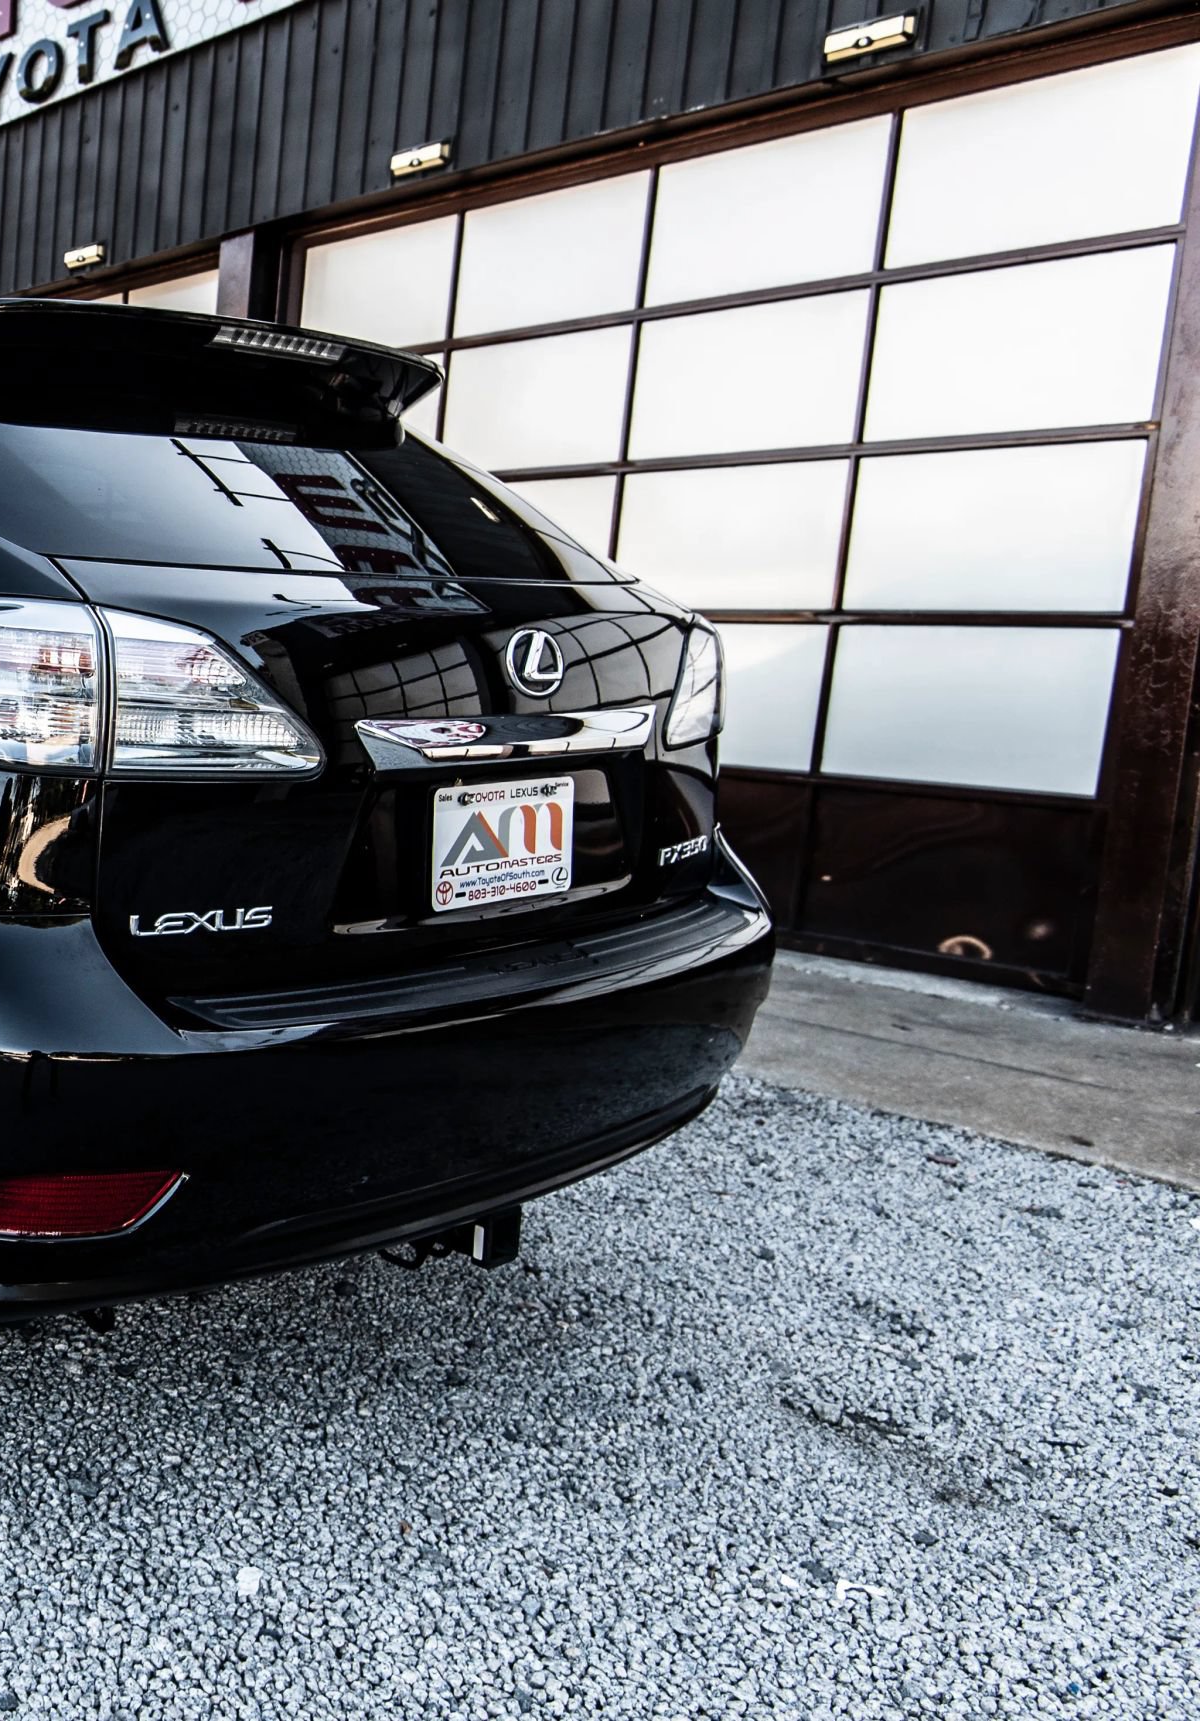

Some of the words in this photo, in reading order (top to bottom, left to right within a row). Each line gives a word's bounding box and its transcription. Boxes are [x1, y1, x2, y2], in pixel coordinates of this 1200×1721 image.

[438, 793, 453, 803] Sales
[510, 786, 539, 799] LEXUS
[439, 853, 563, 879] AUTOMASTERS
[468, 880, 537, 901] 803-310-4600
[129, 905, 274, 937] LEXUS
